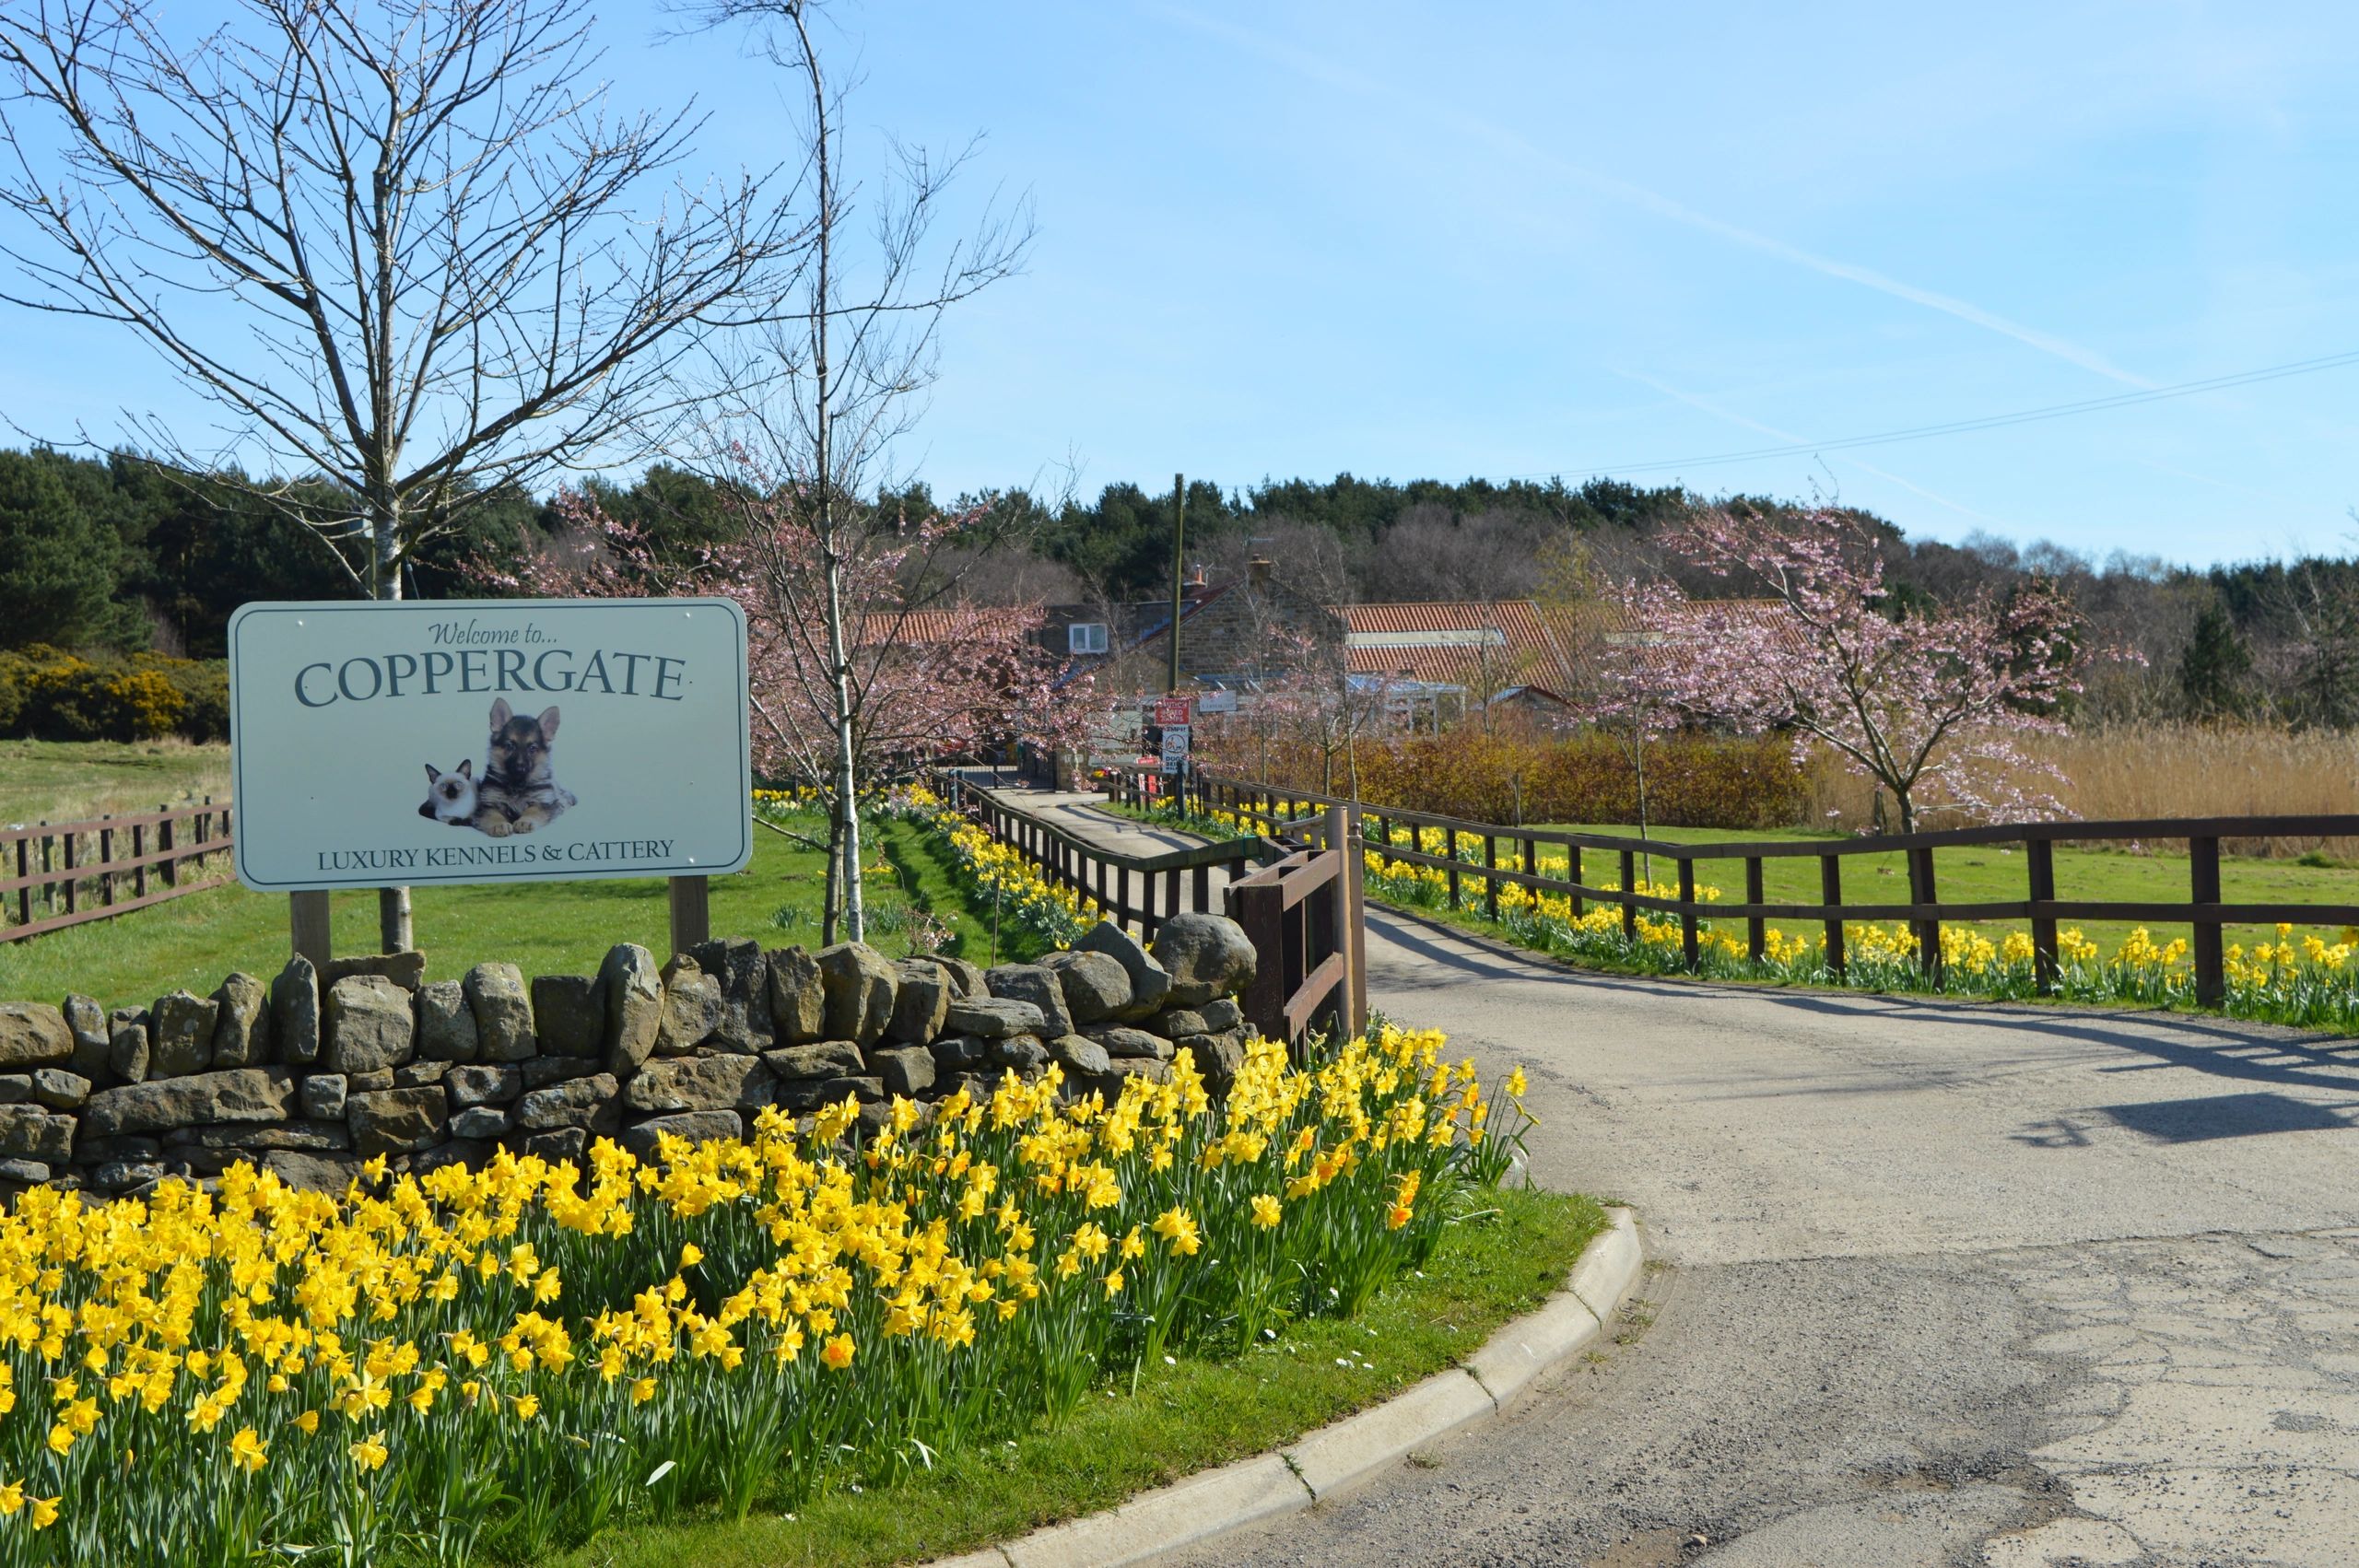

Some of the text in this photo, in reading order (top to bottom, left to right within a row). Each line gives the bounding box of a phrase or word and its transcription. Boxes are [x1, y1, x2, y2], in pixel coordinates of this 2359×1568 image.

[428, 618, 557, 645] Welcome to...
[294, 649, 687, 708] COPPERGATE
[318, 839, 675, 871] LUXURY KENNELS & CATTERY
